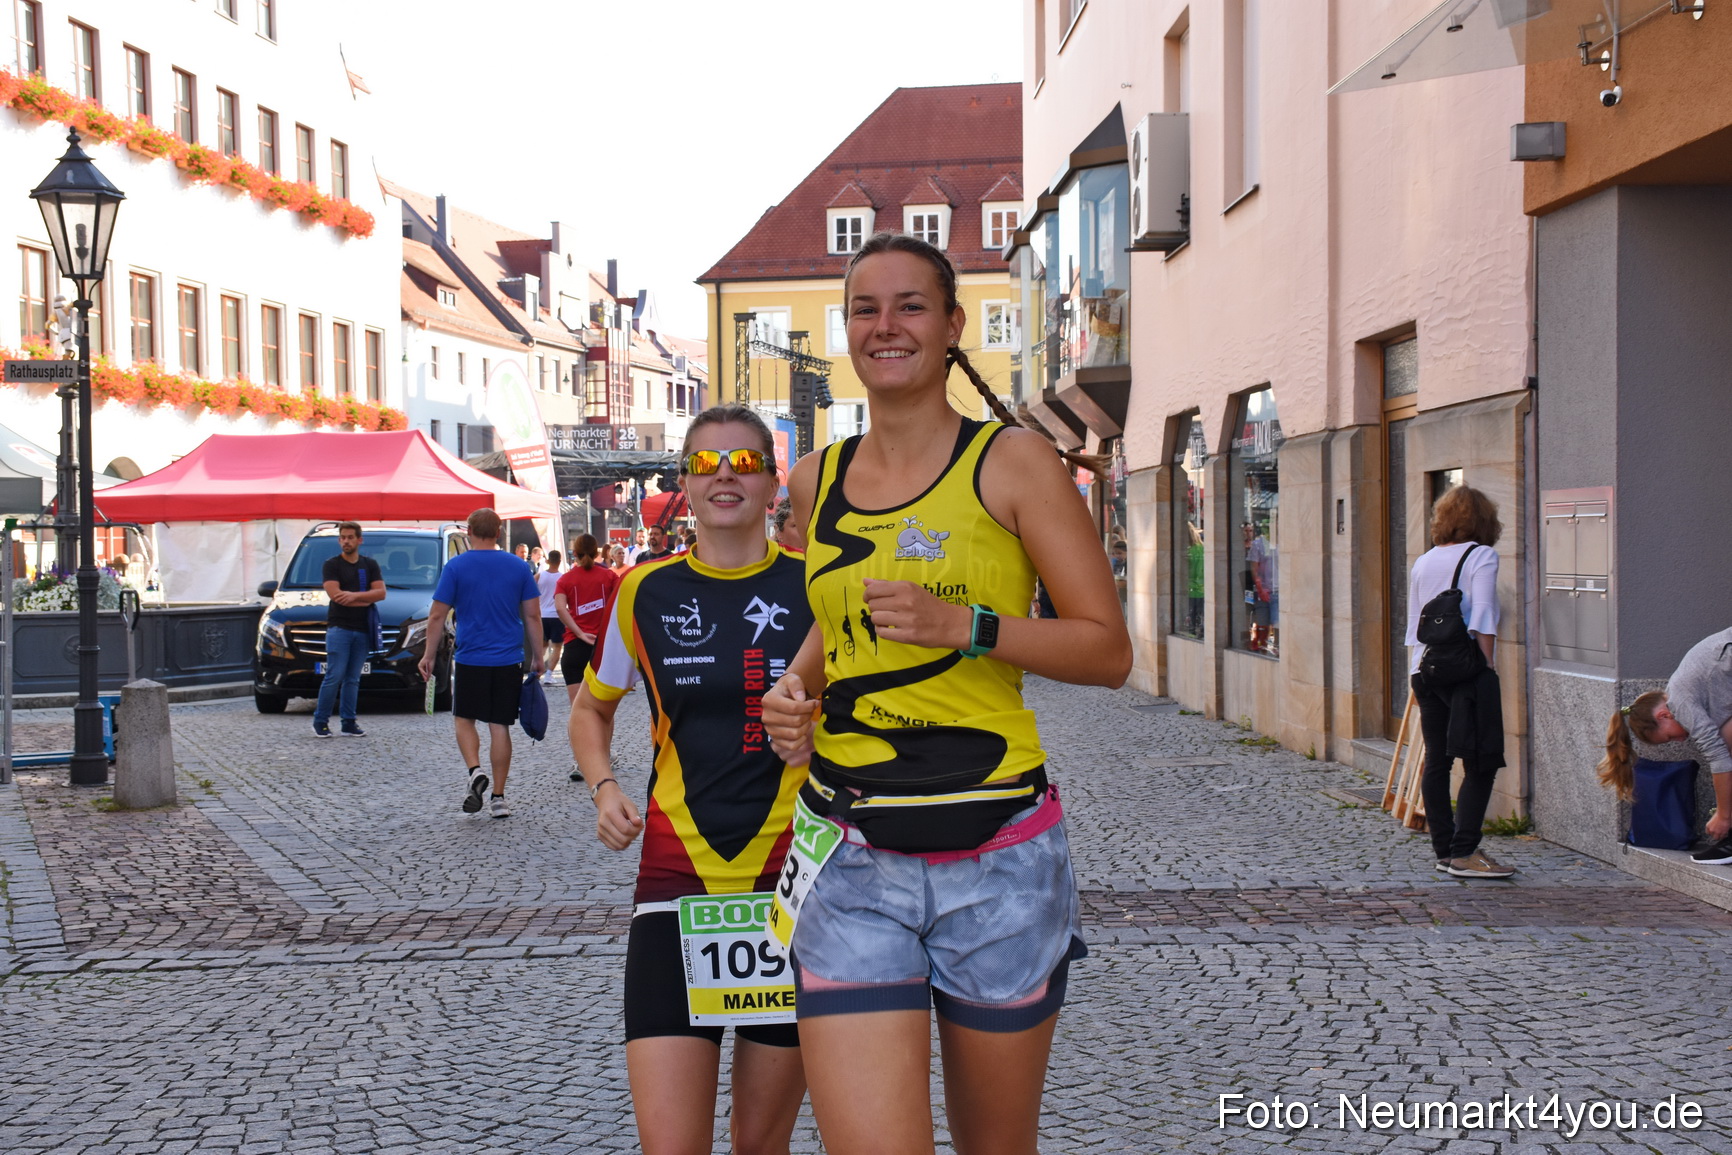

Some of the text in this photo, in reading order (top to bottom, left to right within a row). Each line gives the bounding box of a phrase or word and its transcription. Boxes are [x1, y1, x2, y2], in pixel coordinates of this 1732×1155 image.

[10, 364, 73, 381] Rathausplatz
[548, 427, 611, 438] Neumarkter
[619, 426, 639, 440] 28.
[618, 441, 639, 449] SEPT.
[661, 615, 675, 623] TSG
[675, 676, 701, 686] MAIKE
[742, 649, 765, 754] TSG 08 ROTH
[700, 940, 795, 980] 109
[723, 991, 796, 1009] MAIKE
